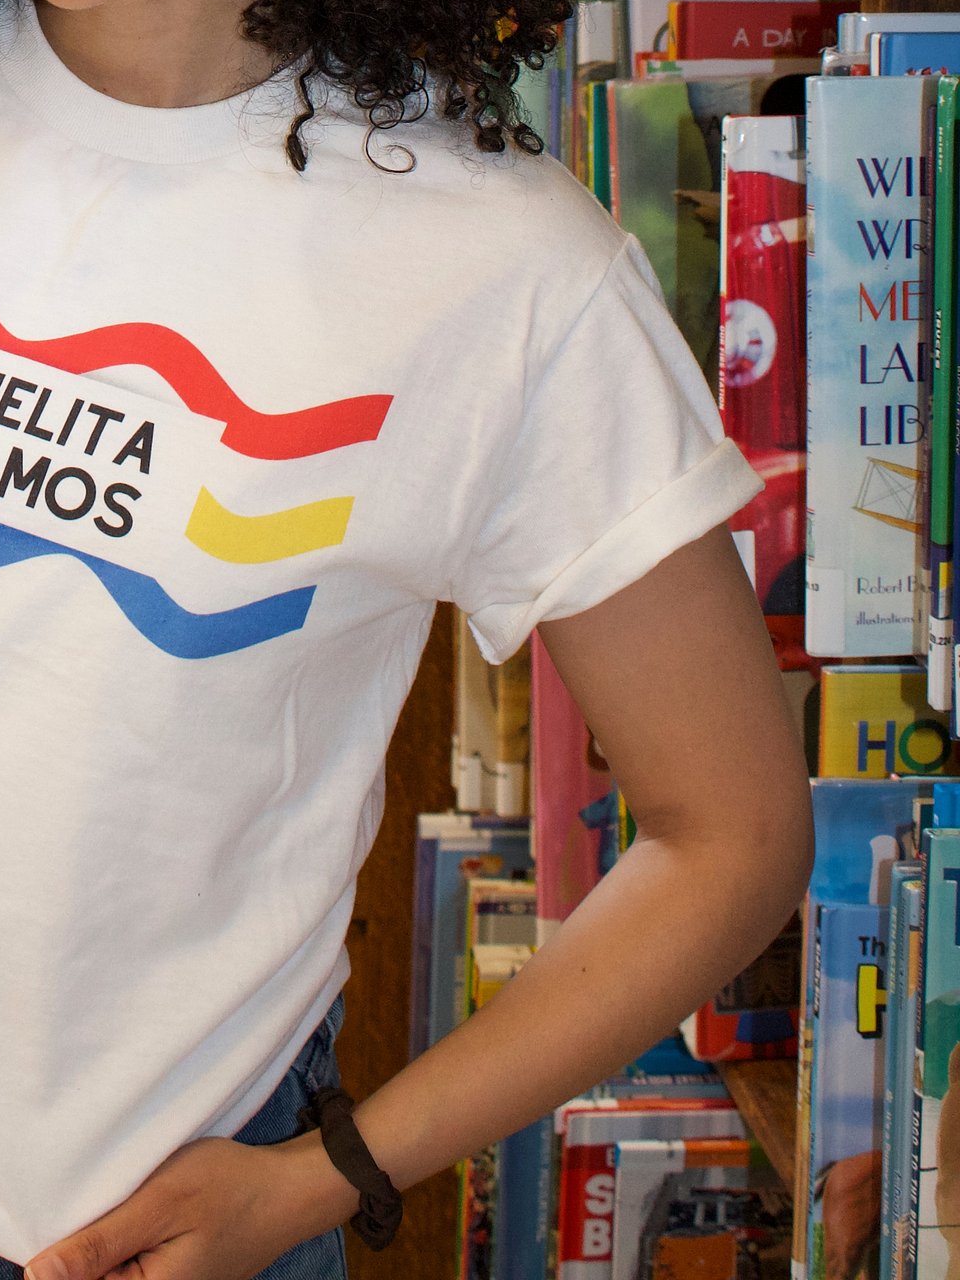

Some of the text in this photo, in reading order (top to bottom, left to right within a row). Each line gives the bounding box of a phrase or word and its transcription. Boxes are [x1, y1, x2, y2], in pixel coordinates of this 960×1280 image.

[732, 27, 750, 49] A
[762, 28, 808, 48] DAY
[856, 575, 902, 594] Robert
[857, 719, 951, 773] HO
